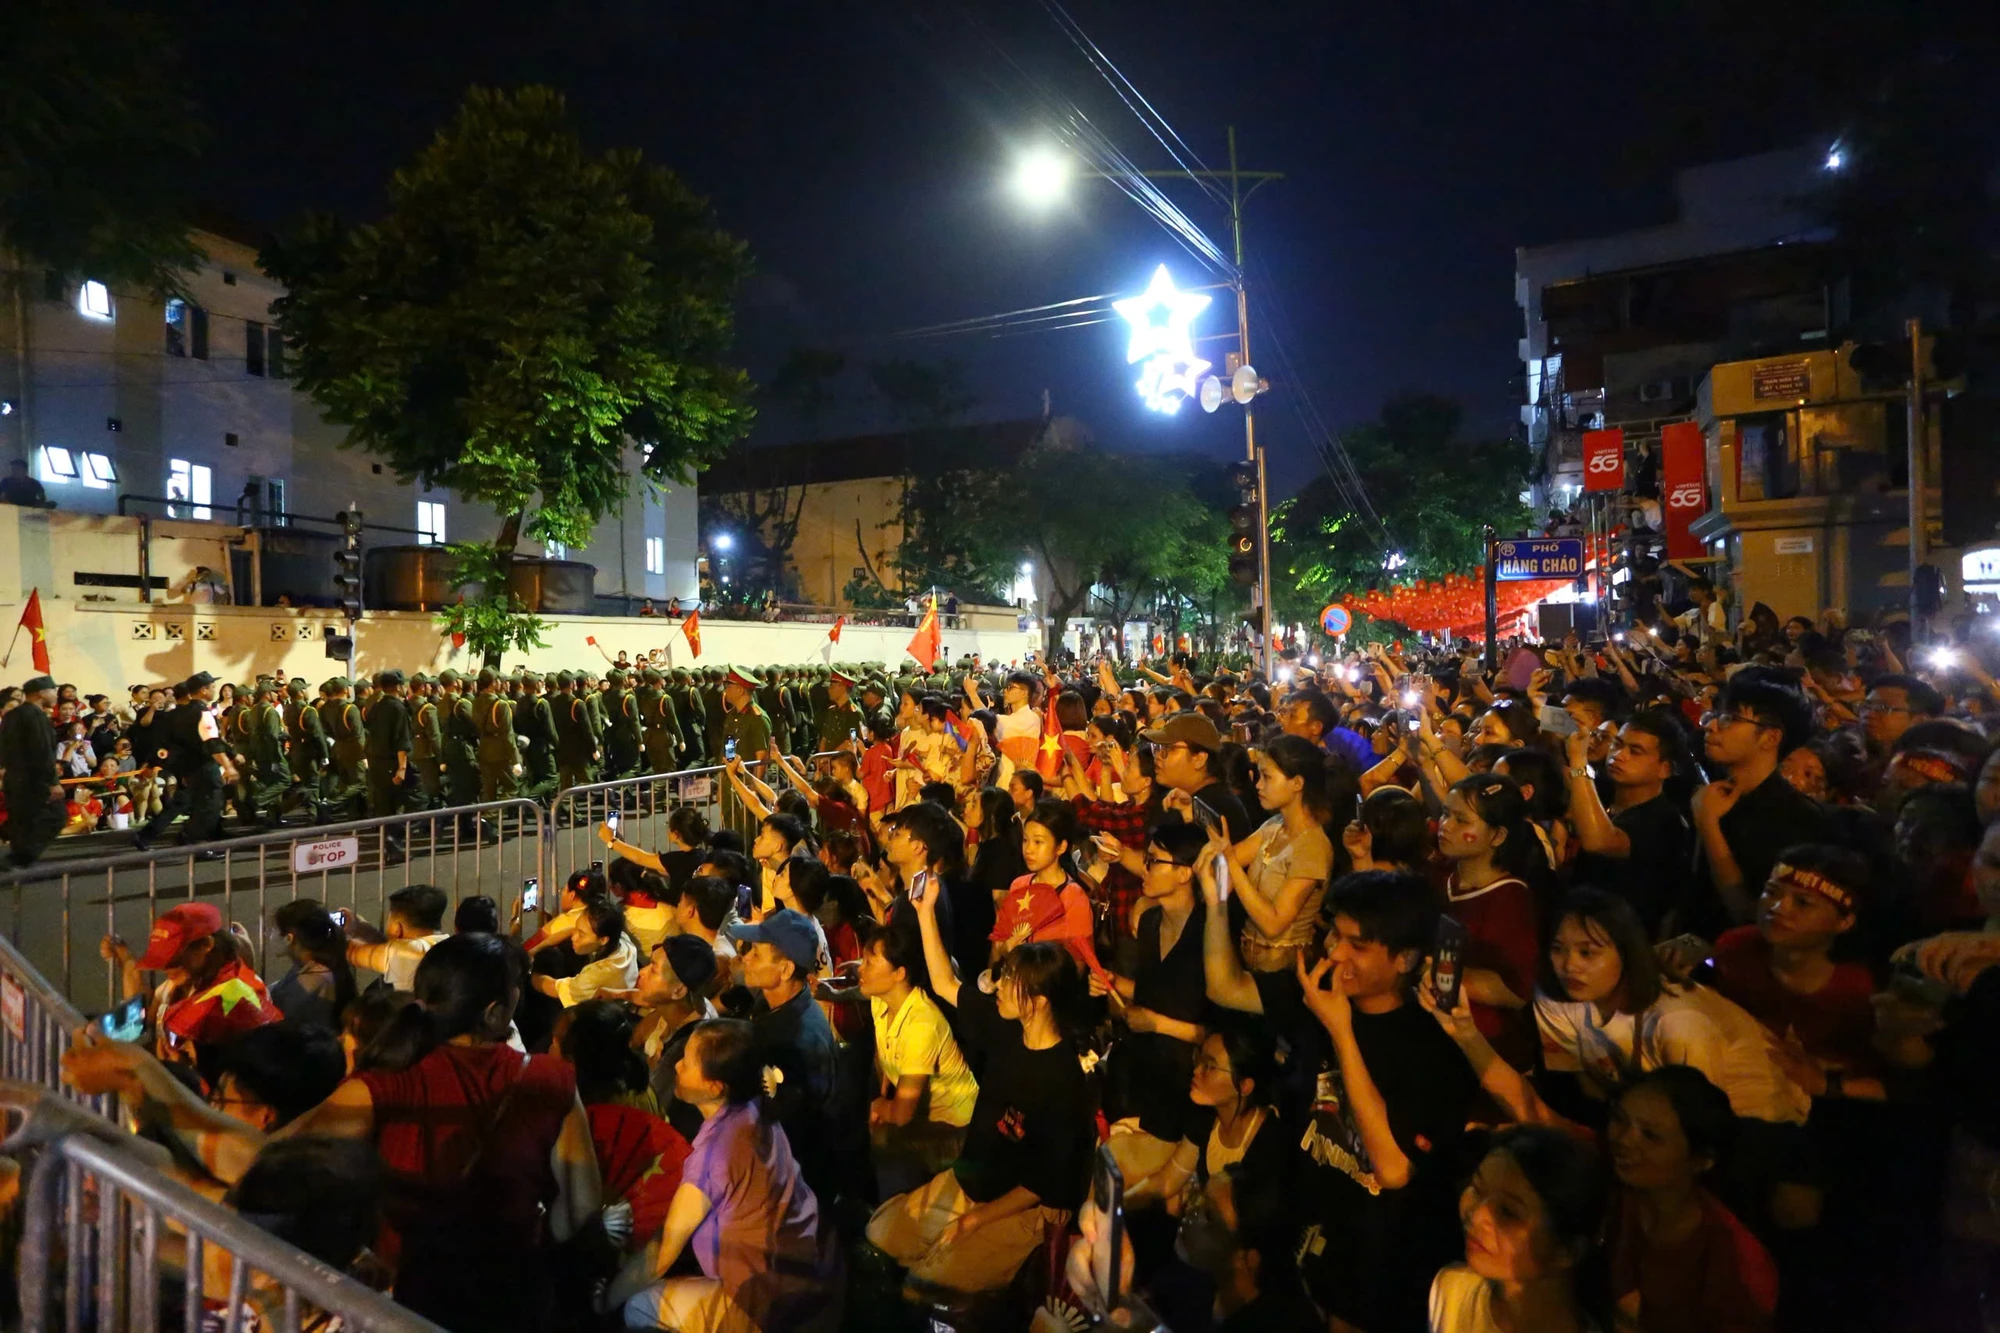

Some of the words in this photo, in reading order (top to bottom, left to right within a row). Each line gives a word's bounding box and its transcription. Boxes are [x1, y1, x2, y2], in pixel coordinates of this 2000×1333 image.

[1589, 454, 1619, 473] 5G
[1669, 488, 1701, 508] 5G
[1532, 540, 1559, 552] PHỐ
[1503, 555, 1538, 574] HÀNG
[1542, 554, 1577, 573] CHÁO
[312, 841, 342, 851] POLICE
